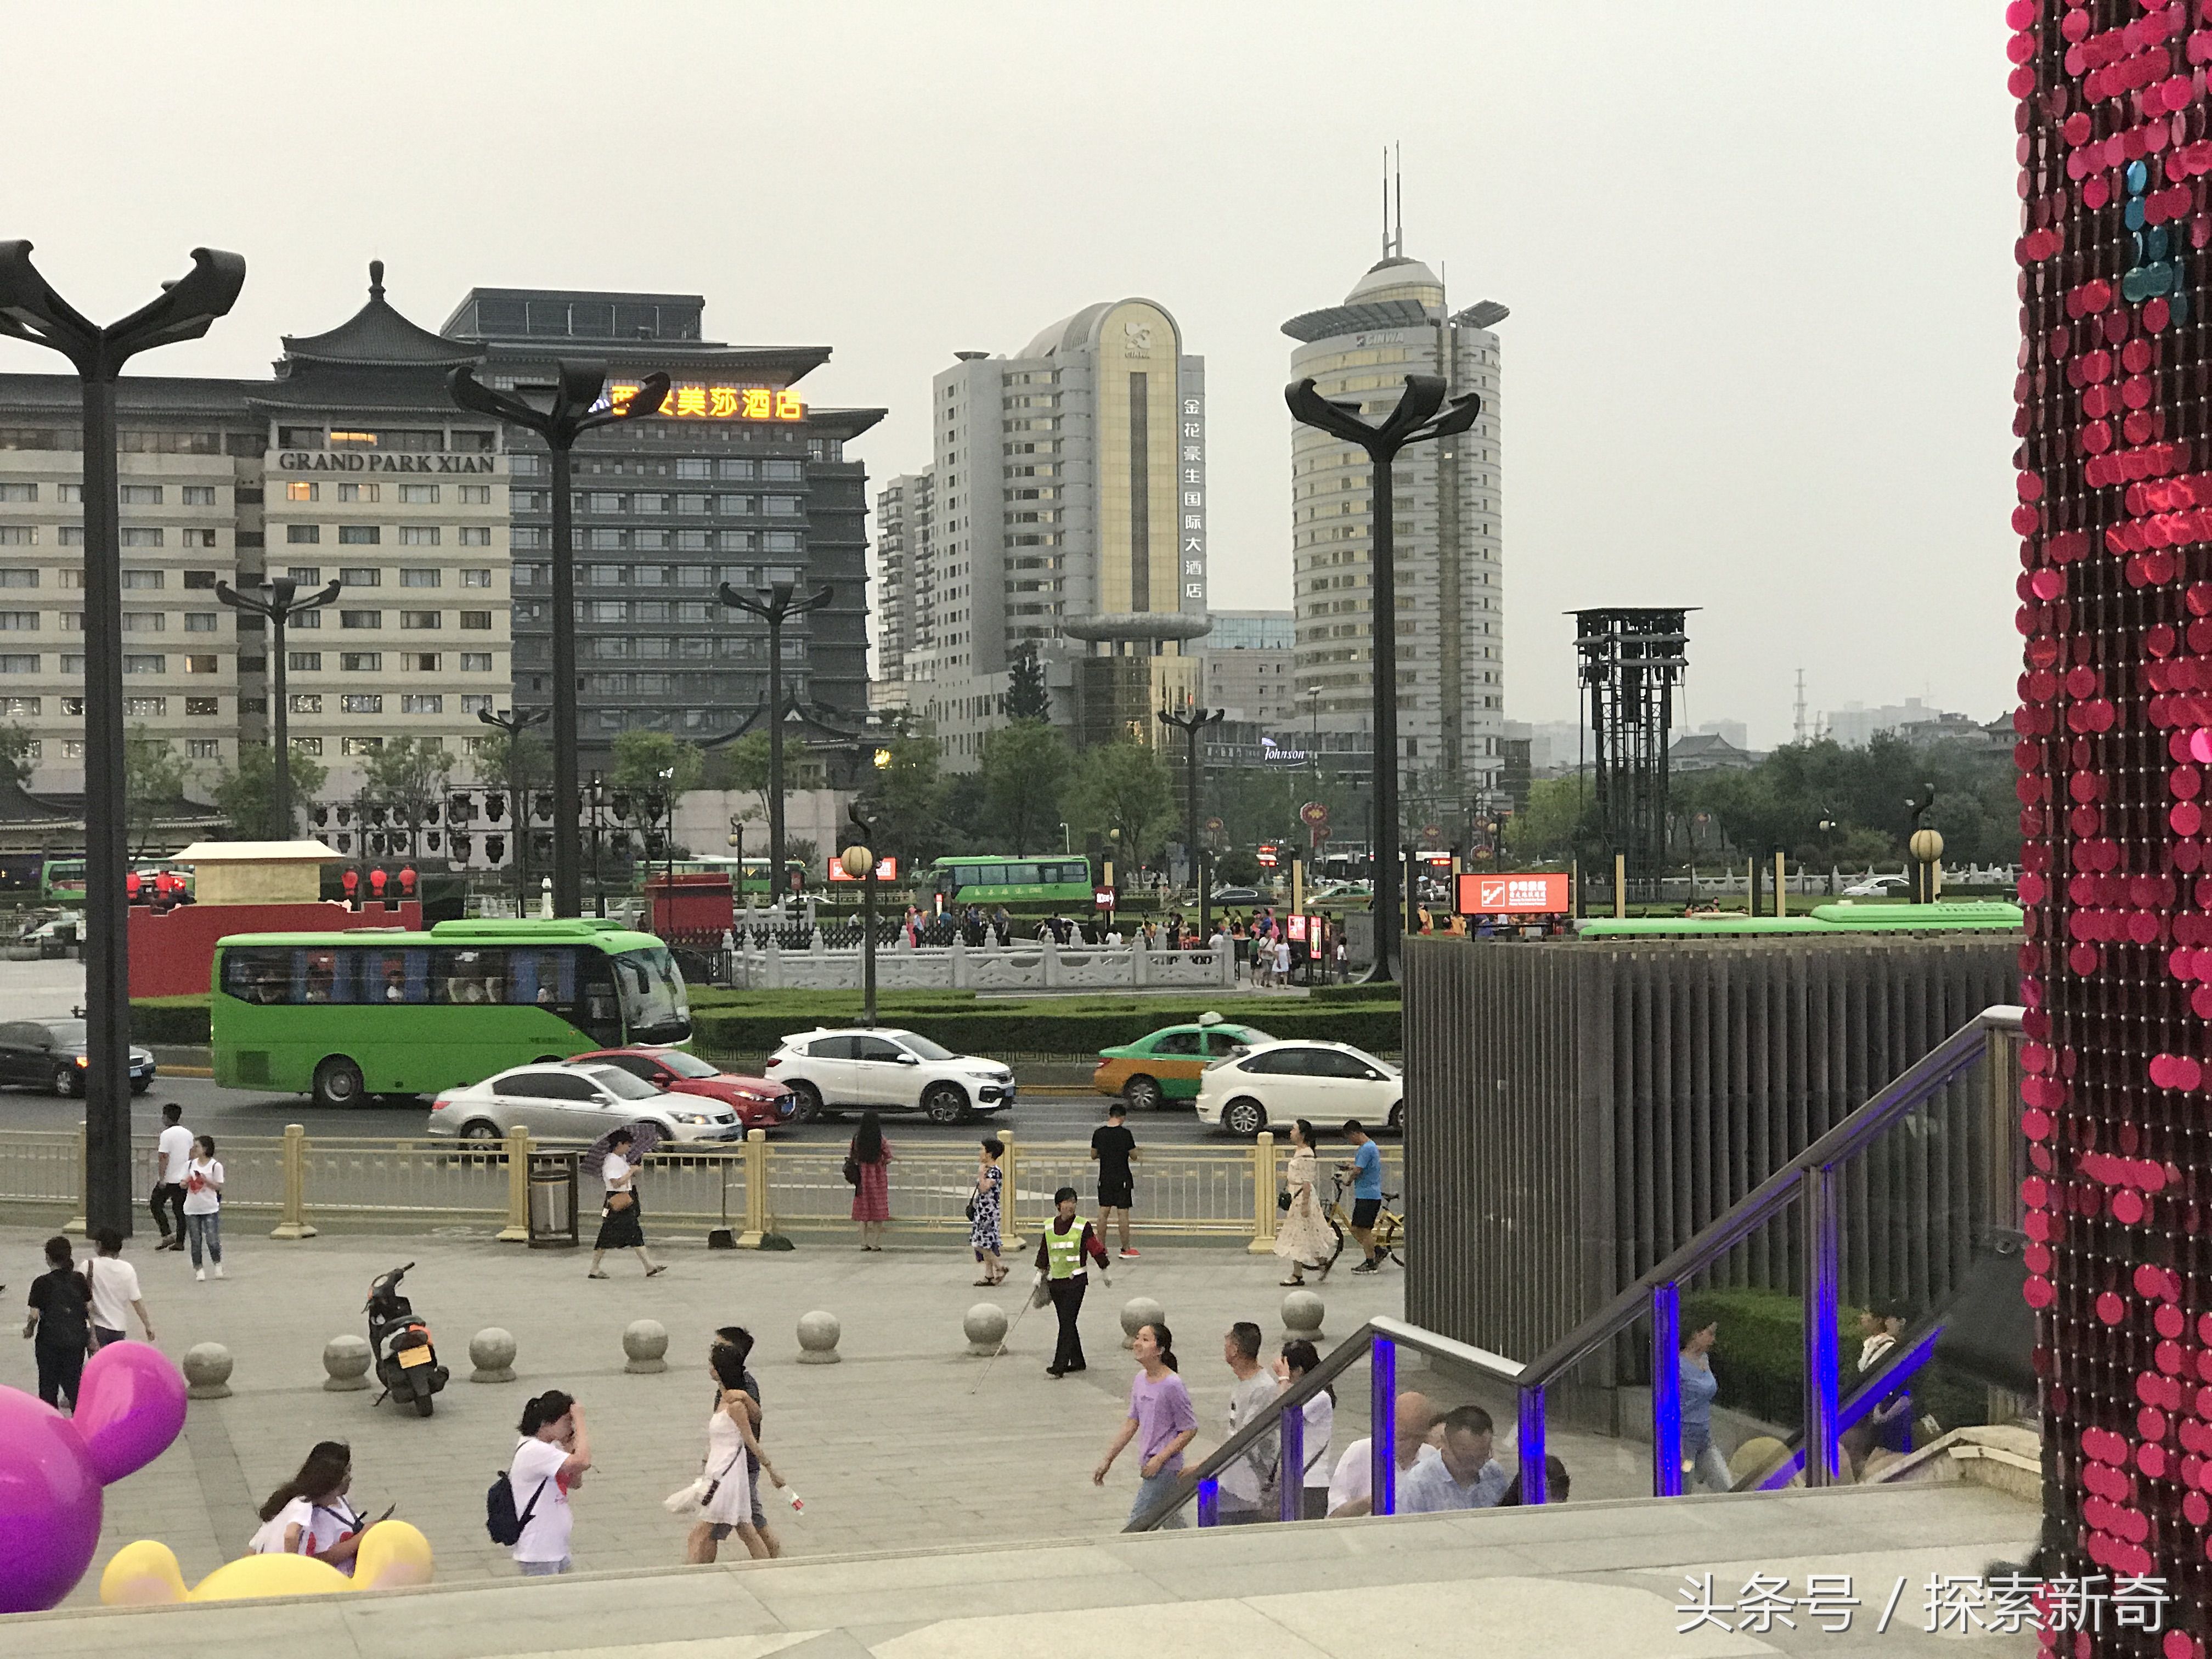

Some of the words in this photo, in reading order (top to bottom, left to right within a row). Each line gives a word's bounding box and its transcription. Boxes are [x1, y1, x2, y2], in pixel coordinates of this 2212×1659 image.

[279, 453, 364, 471] GRAND
[369, 454, 432, 472] PARK
[437, 456, 494, 473] XIAN
[1183, 399, 1202, 599] 金花豪生国际大酒店
[1265, 746, 1305, 760] Johnson
